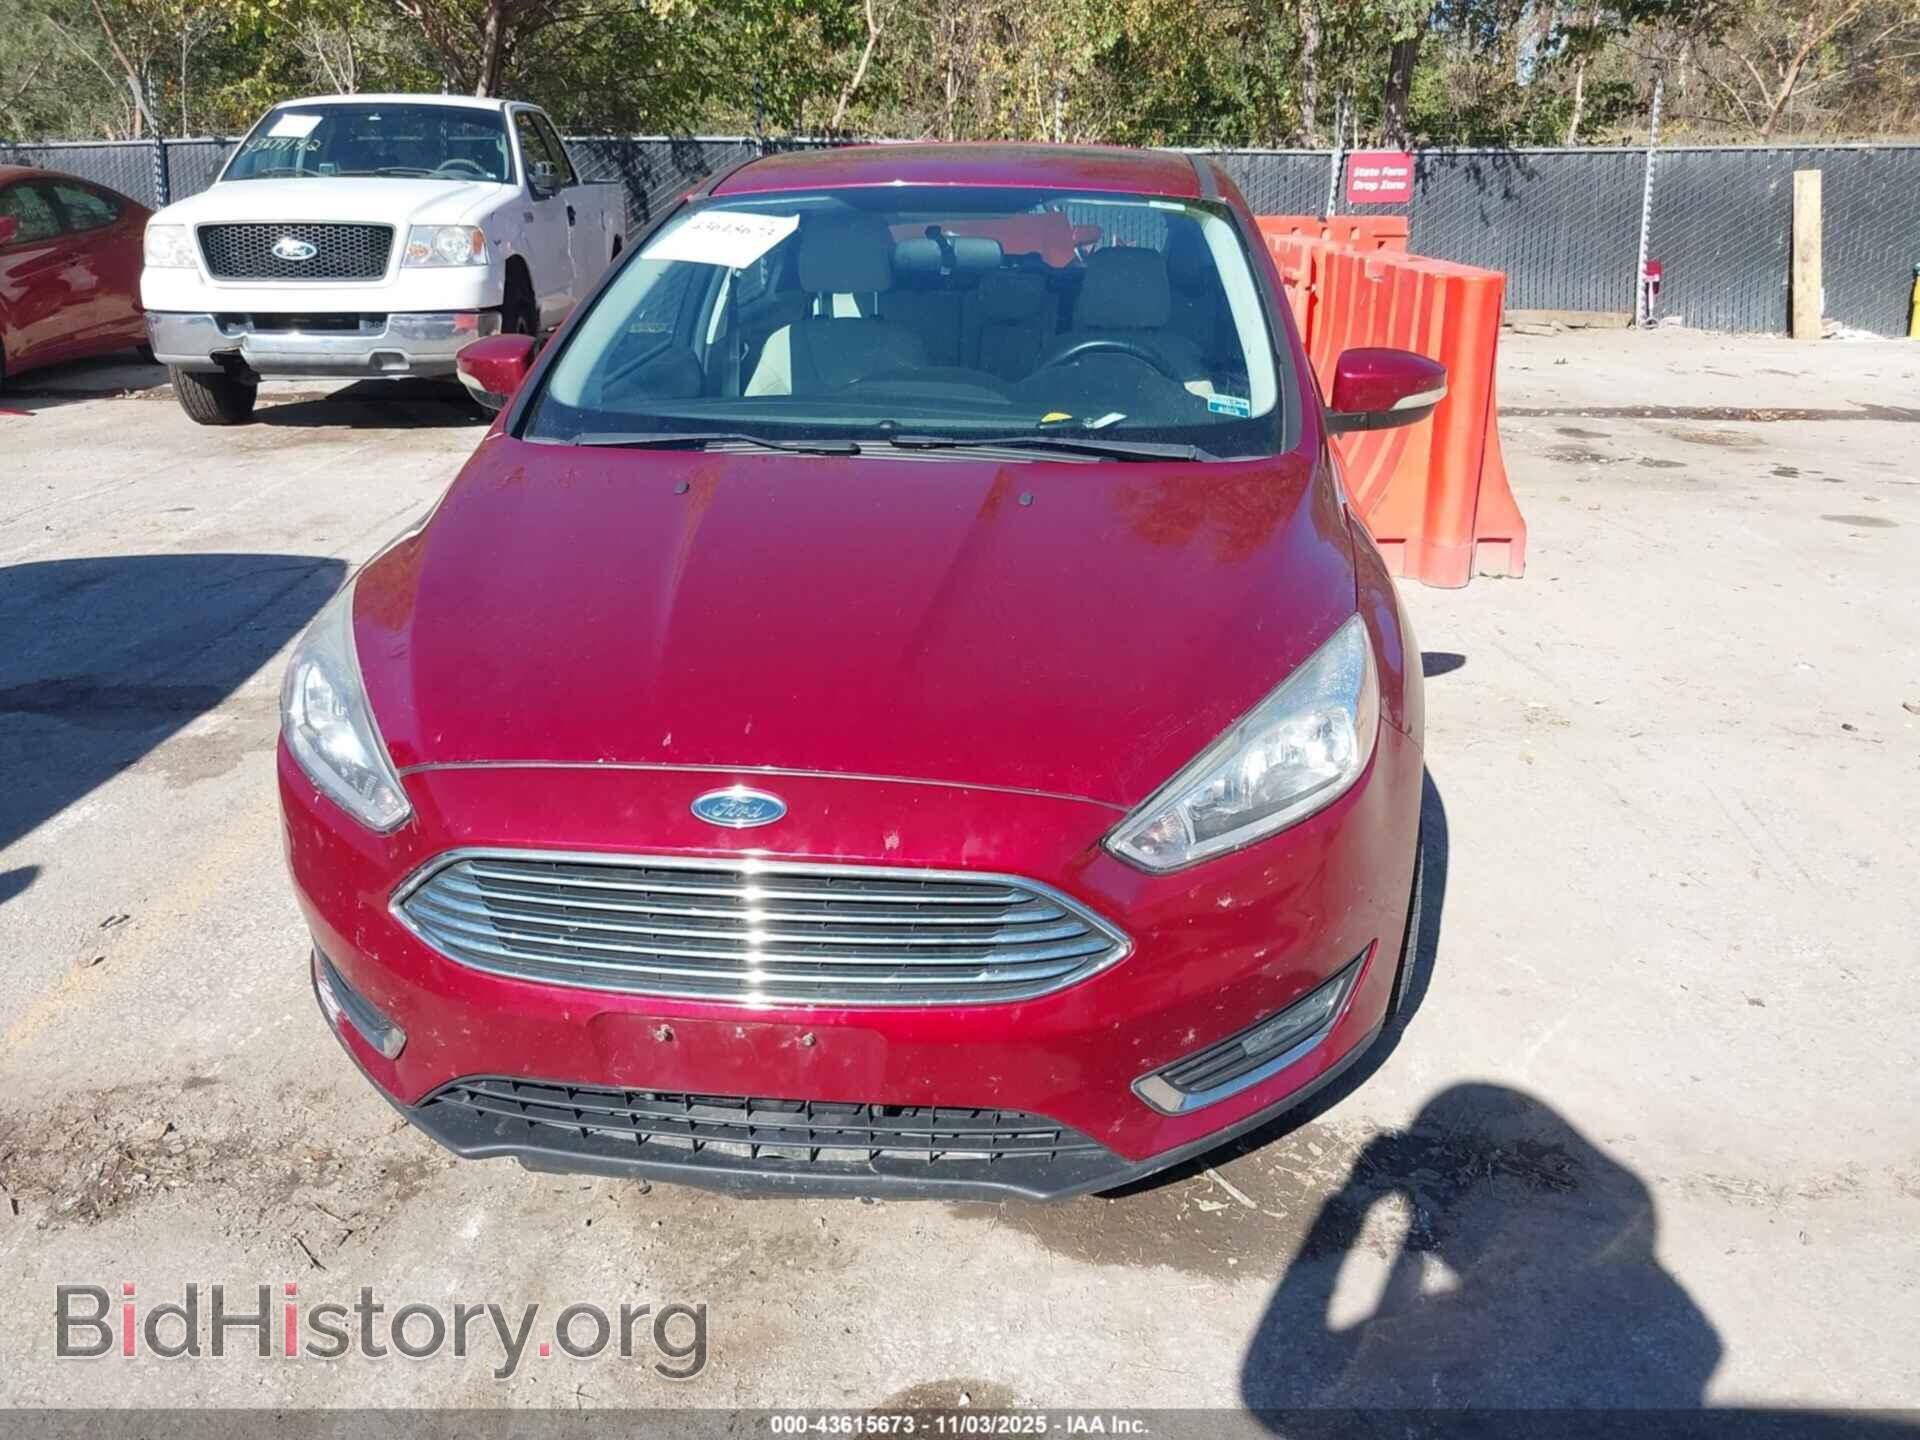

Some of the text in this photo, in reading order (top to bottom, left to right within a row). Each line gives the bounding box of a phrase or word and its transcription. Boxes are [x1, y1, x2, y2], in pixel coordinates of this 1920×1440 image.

[1353, 166, 1408, 177] State Farm
[1352, 180, 1407, 191] Drop Zone
[706, 797, 766, 818] Ford
